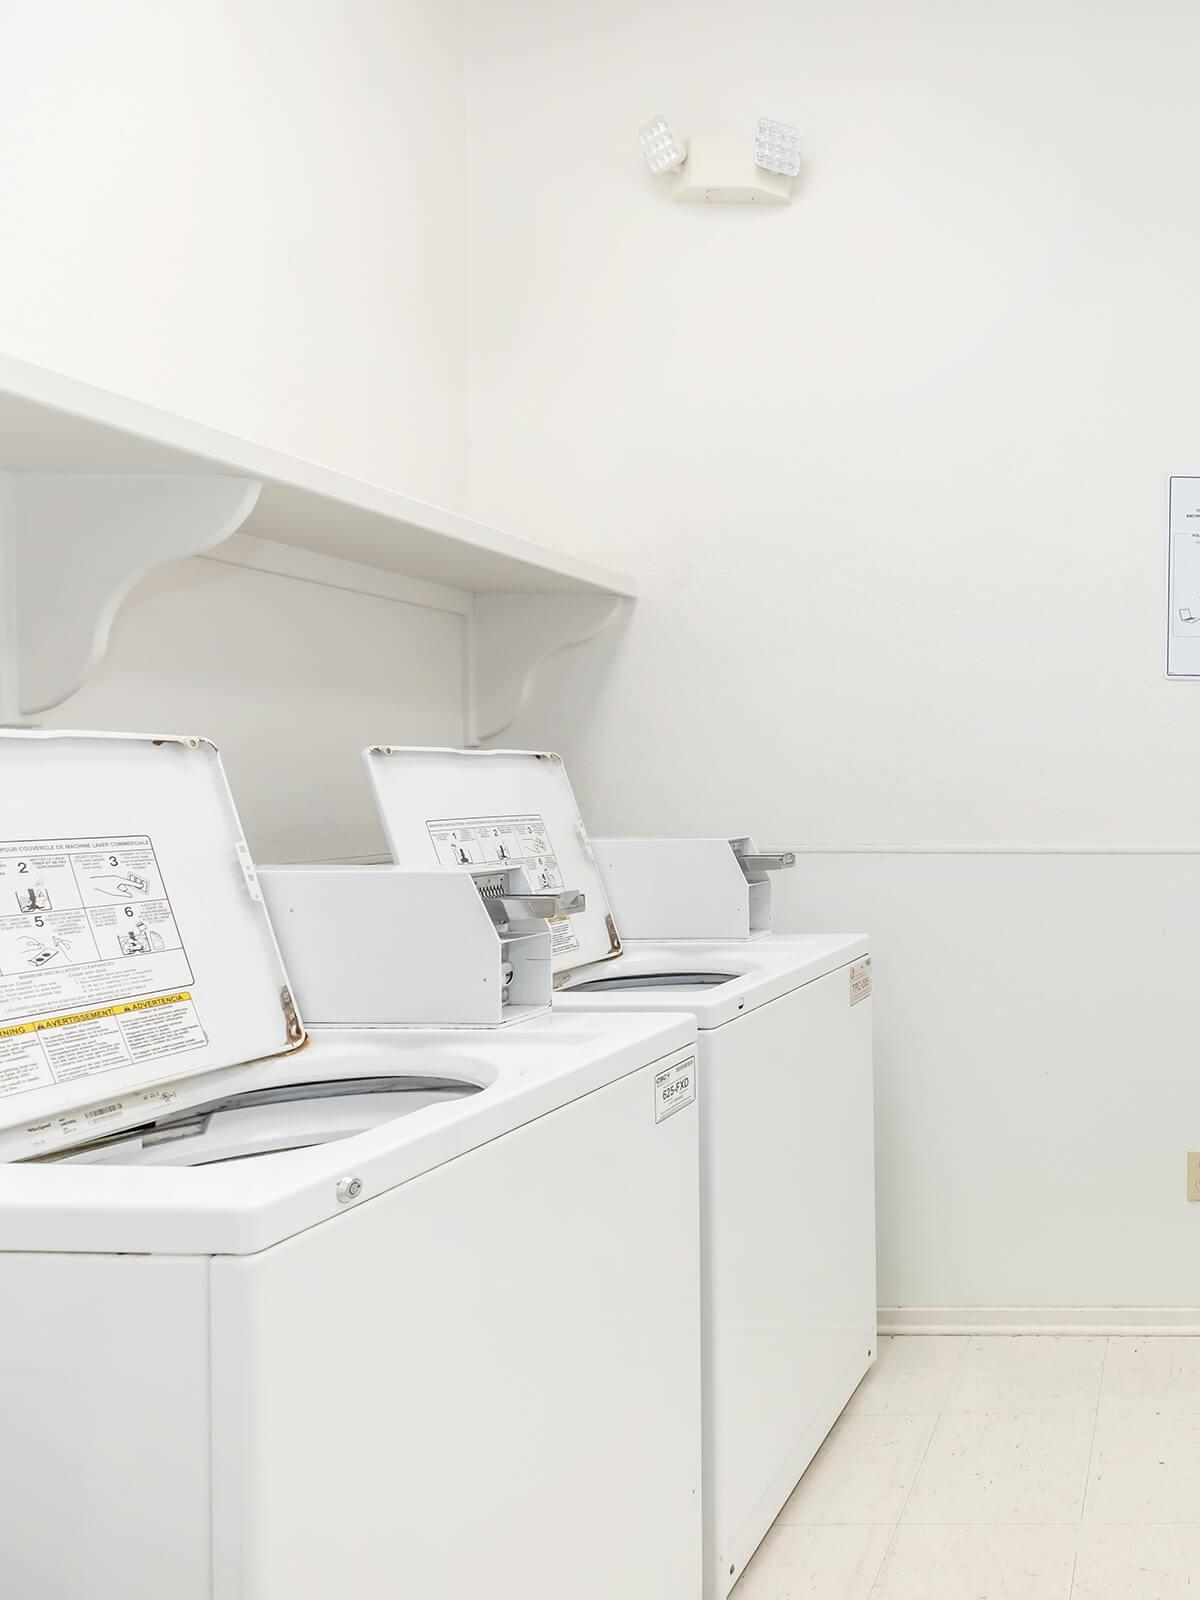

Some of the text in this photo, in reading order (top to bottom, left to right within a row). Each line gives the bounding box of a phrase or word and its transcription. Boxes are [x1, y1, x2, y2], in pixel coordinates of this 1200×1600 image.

[109, 855, 119, 867] 3
[17, 862, 29, 873] 2
[124, 906, 134, 917] 6
[34, 915, 44, 927] 5
[132, 994, 184, 1011] ADVERTENCIA
[46, 1008, 113, 1028] AVERTISSEMENT
[0, 1026, 26, 1038] NING
[662, 1077, 689, 1101] 625-FXD
